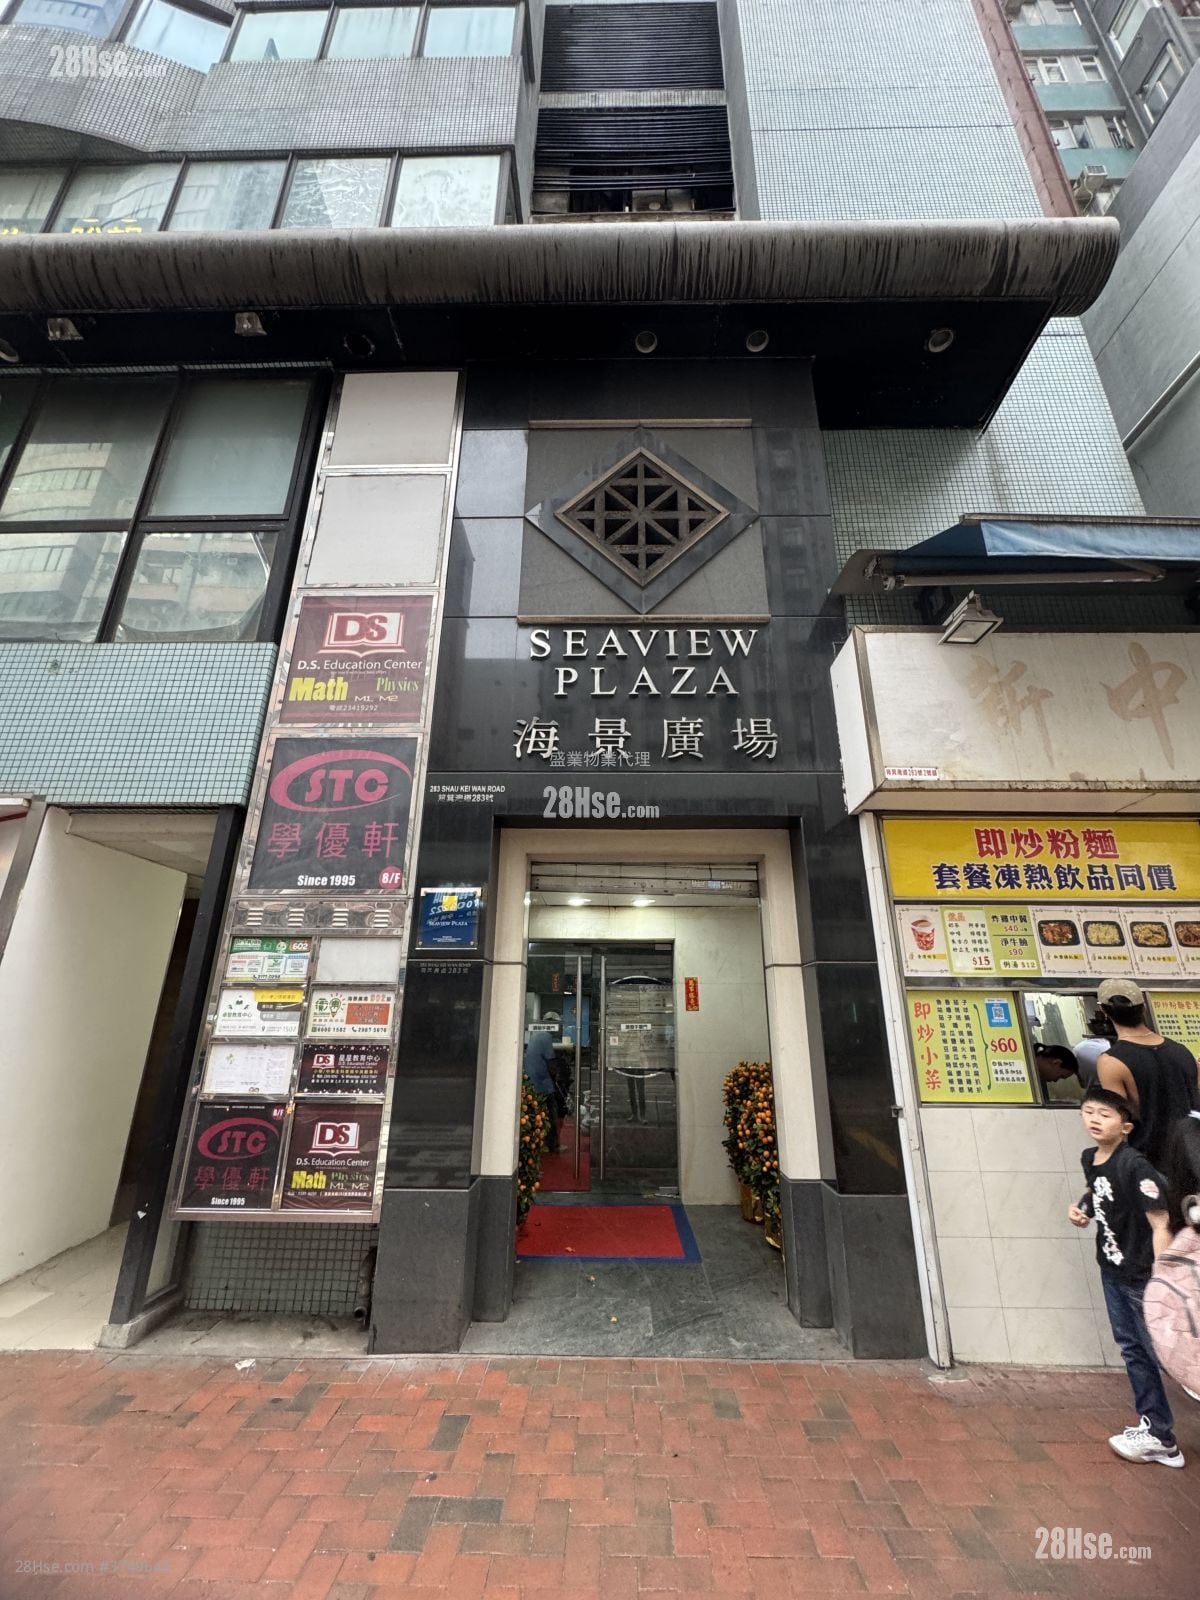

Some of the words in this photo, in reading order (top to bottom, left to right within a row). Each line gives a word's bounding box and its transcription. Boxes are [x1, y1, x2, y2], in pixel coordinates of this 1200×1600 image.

[333, 613, 389, 642] DS
[530, 629, 758, 659] SEAVIEW
[297, 660, 321, 671] D.S.
[323, 659, 381, 671] Education
[384, 658, 423, 670] Center
[289, 676, 349, 701] Math
[376, 676, 420, 694] Physics
[554, 666, 739, 697] PLAZA
[513, 716, 778, 759] 海景廣場
[305, 768, 389, 802] STC
[429, 785, 440, 793] 283
[441, 785, 459, 793] SHAU
[460, 785, 471, 793] KEI
[471, 785, 486, 793] WAN
[487, 785, 506, 793] ROAD
[268, 821, 399, 859] 學優軒
[975, 828, 1120, 860] 即炒粉麵
[297, 874, 327, 887] Since
[329, 874, 356, 887] 1995
[381, 872, 400, 885] 8/F
[932, 863, 1178, 891] 套餐凍熱飲品同價
[292, 942, 308, 950] 602
[972, 956, 991, 966] $15
[914, 1002, 942, 1091] 即炒小菜
[990, 1037, 1018, 1053] $60
[316, 1055, 331, 1065] DS
[217, 1131, 267, 1154] STC
[318, 1123, 351, 1145] DS
[296, 1158, 310, 1166] D.S.
[311, 1158, 346, 1166] Education
[346, 1158, 370, 1167] Center
[194, 1166, 271, 1191] 學優軒
[291, 1170, 327, 1189] Math
[331, 1172, 370, 1182] Physics
[351, 1182, 369, 1190] M2
[210, 1197, 229, 1206] Since
[230, 1197, 246, 1206] 1995
